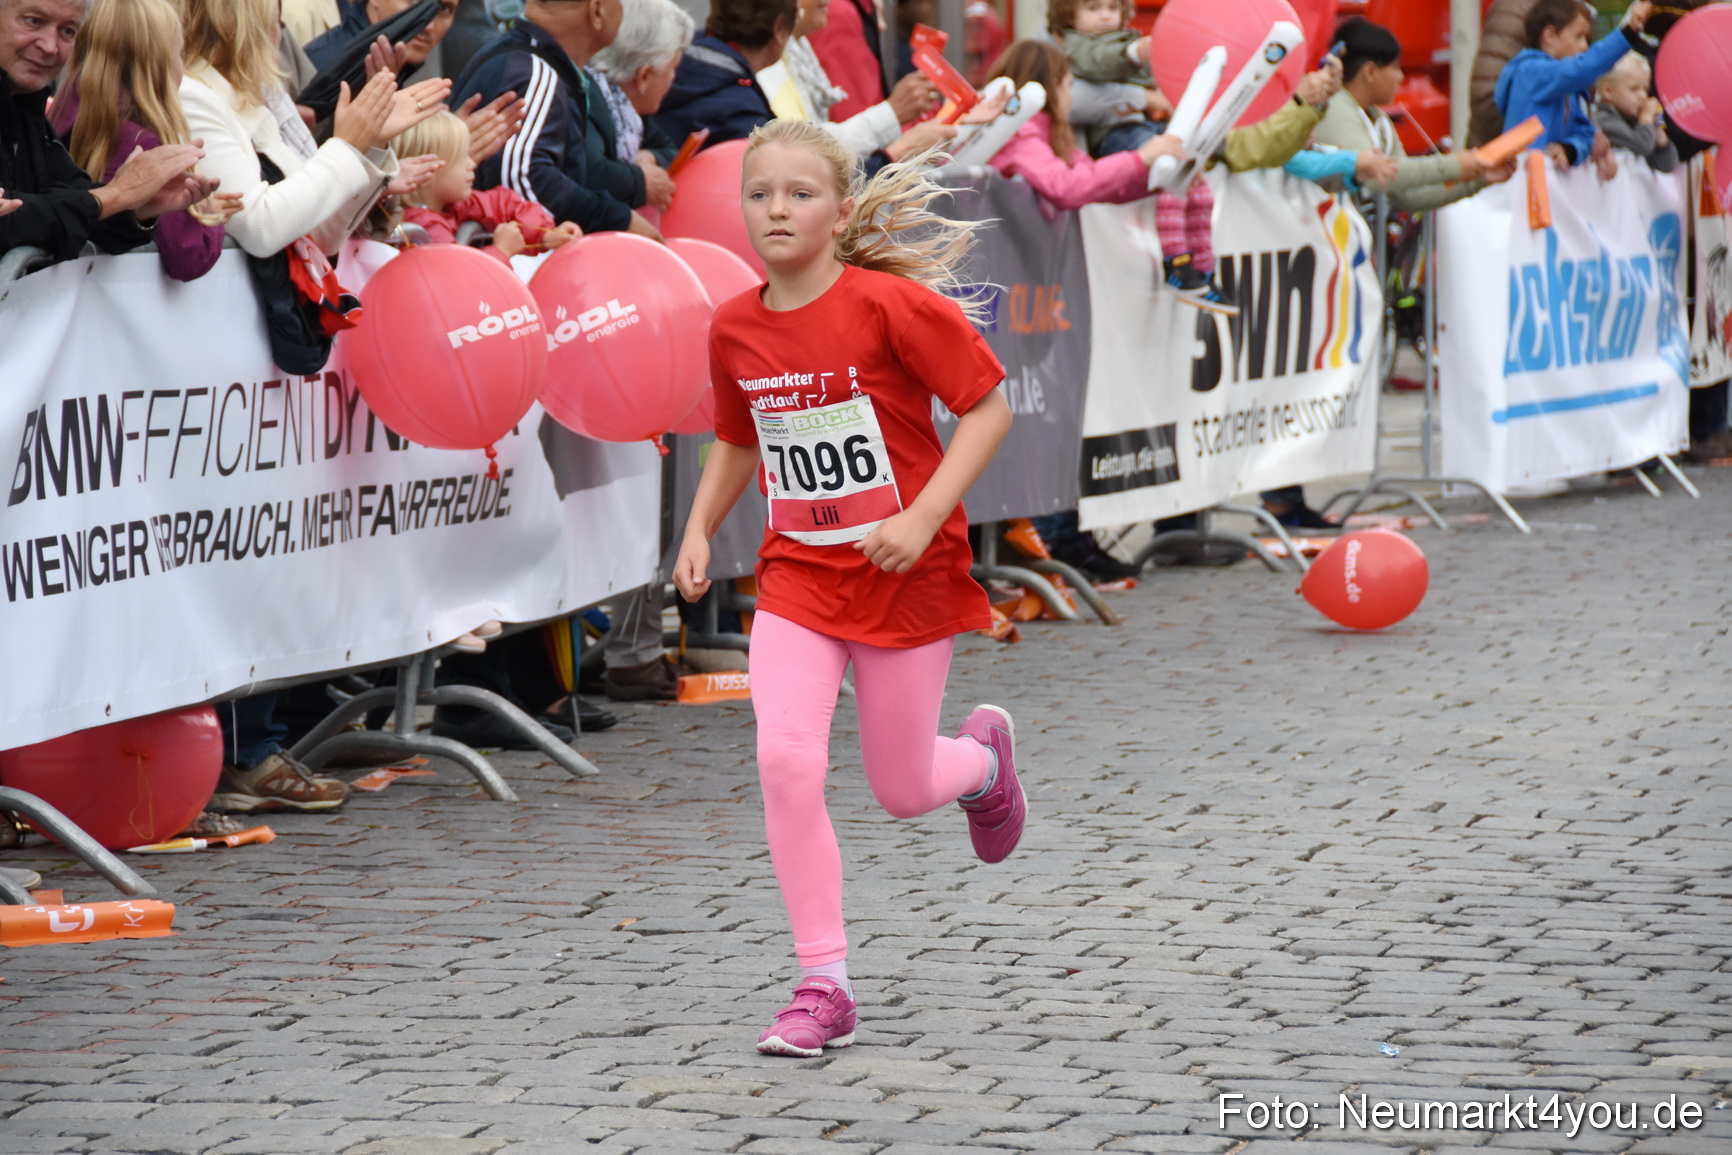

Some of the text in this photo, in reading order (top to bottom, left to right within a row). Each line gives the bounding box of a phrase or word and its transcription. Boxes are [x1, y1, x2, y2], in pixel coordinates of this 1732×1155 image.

[509, 322, 541, 340] energie
[586, 312, 640, 343] energie
[792, 403, 864, 432] BOCK
[7, 393, 124, 507] BMW
[767, 434, 877, 493] 7096
[773, 488, 778, 497] 5
[882, 473, 889, 483] K
[811, 505, 840, 526] Lili
[2, 519, 150, 602] WENIGER
[301, 487, 353, 551] MEHR
[357, 468, 514, 538] FAHRFREUDE.
